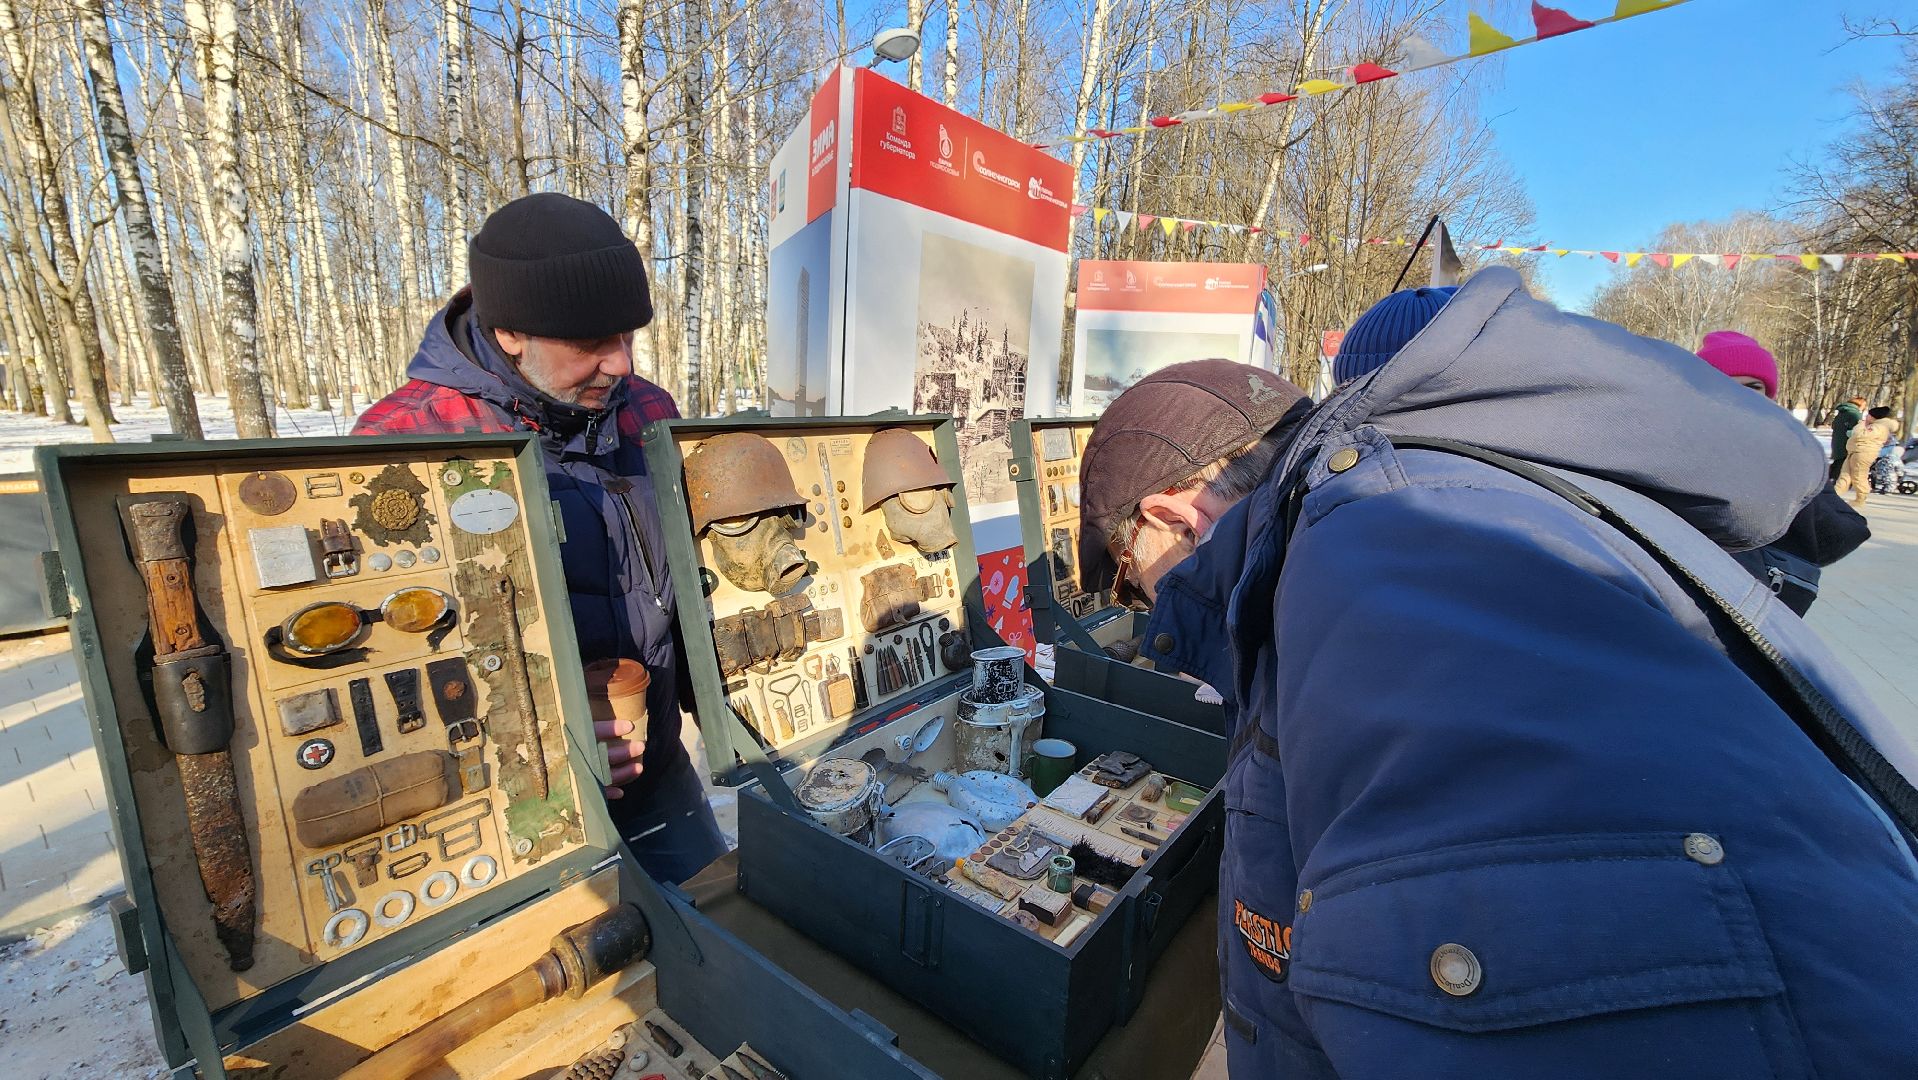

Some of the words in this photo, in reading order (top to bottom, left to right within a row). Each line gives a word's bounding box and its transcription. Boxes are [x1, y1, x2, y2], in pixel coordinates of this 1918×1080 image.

[811, 119, 835, 164] ЗИМА
[879, 140, 916, 160] губернатора
[885, 131, 912, 149] Команда
